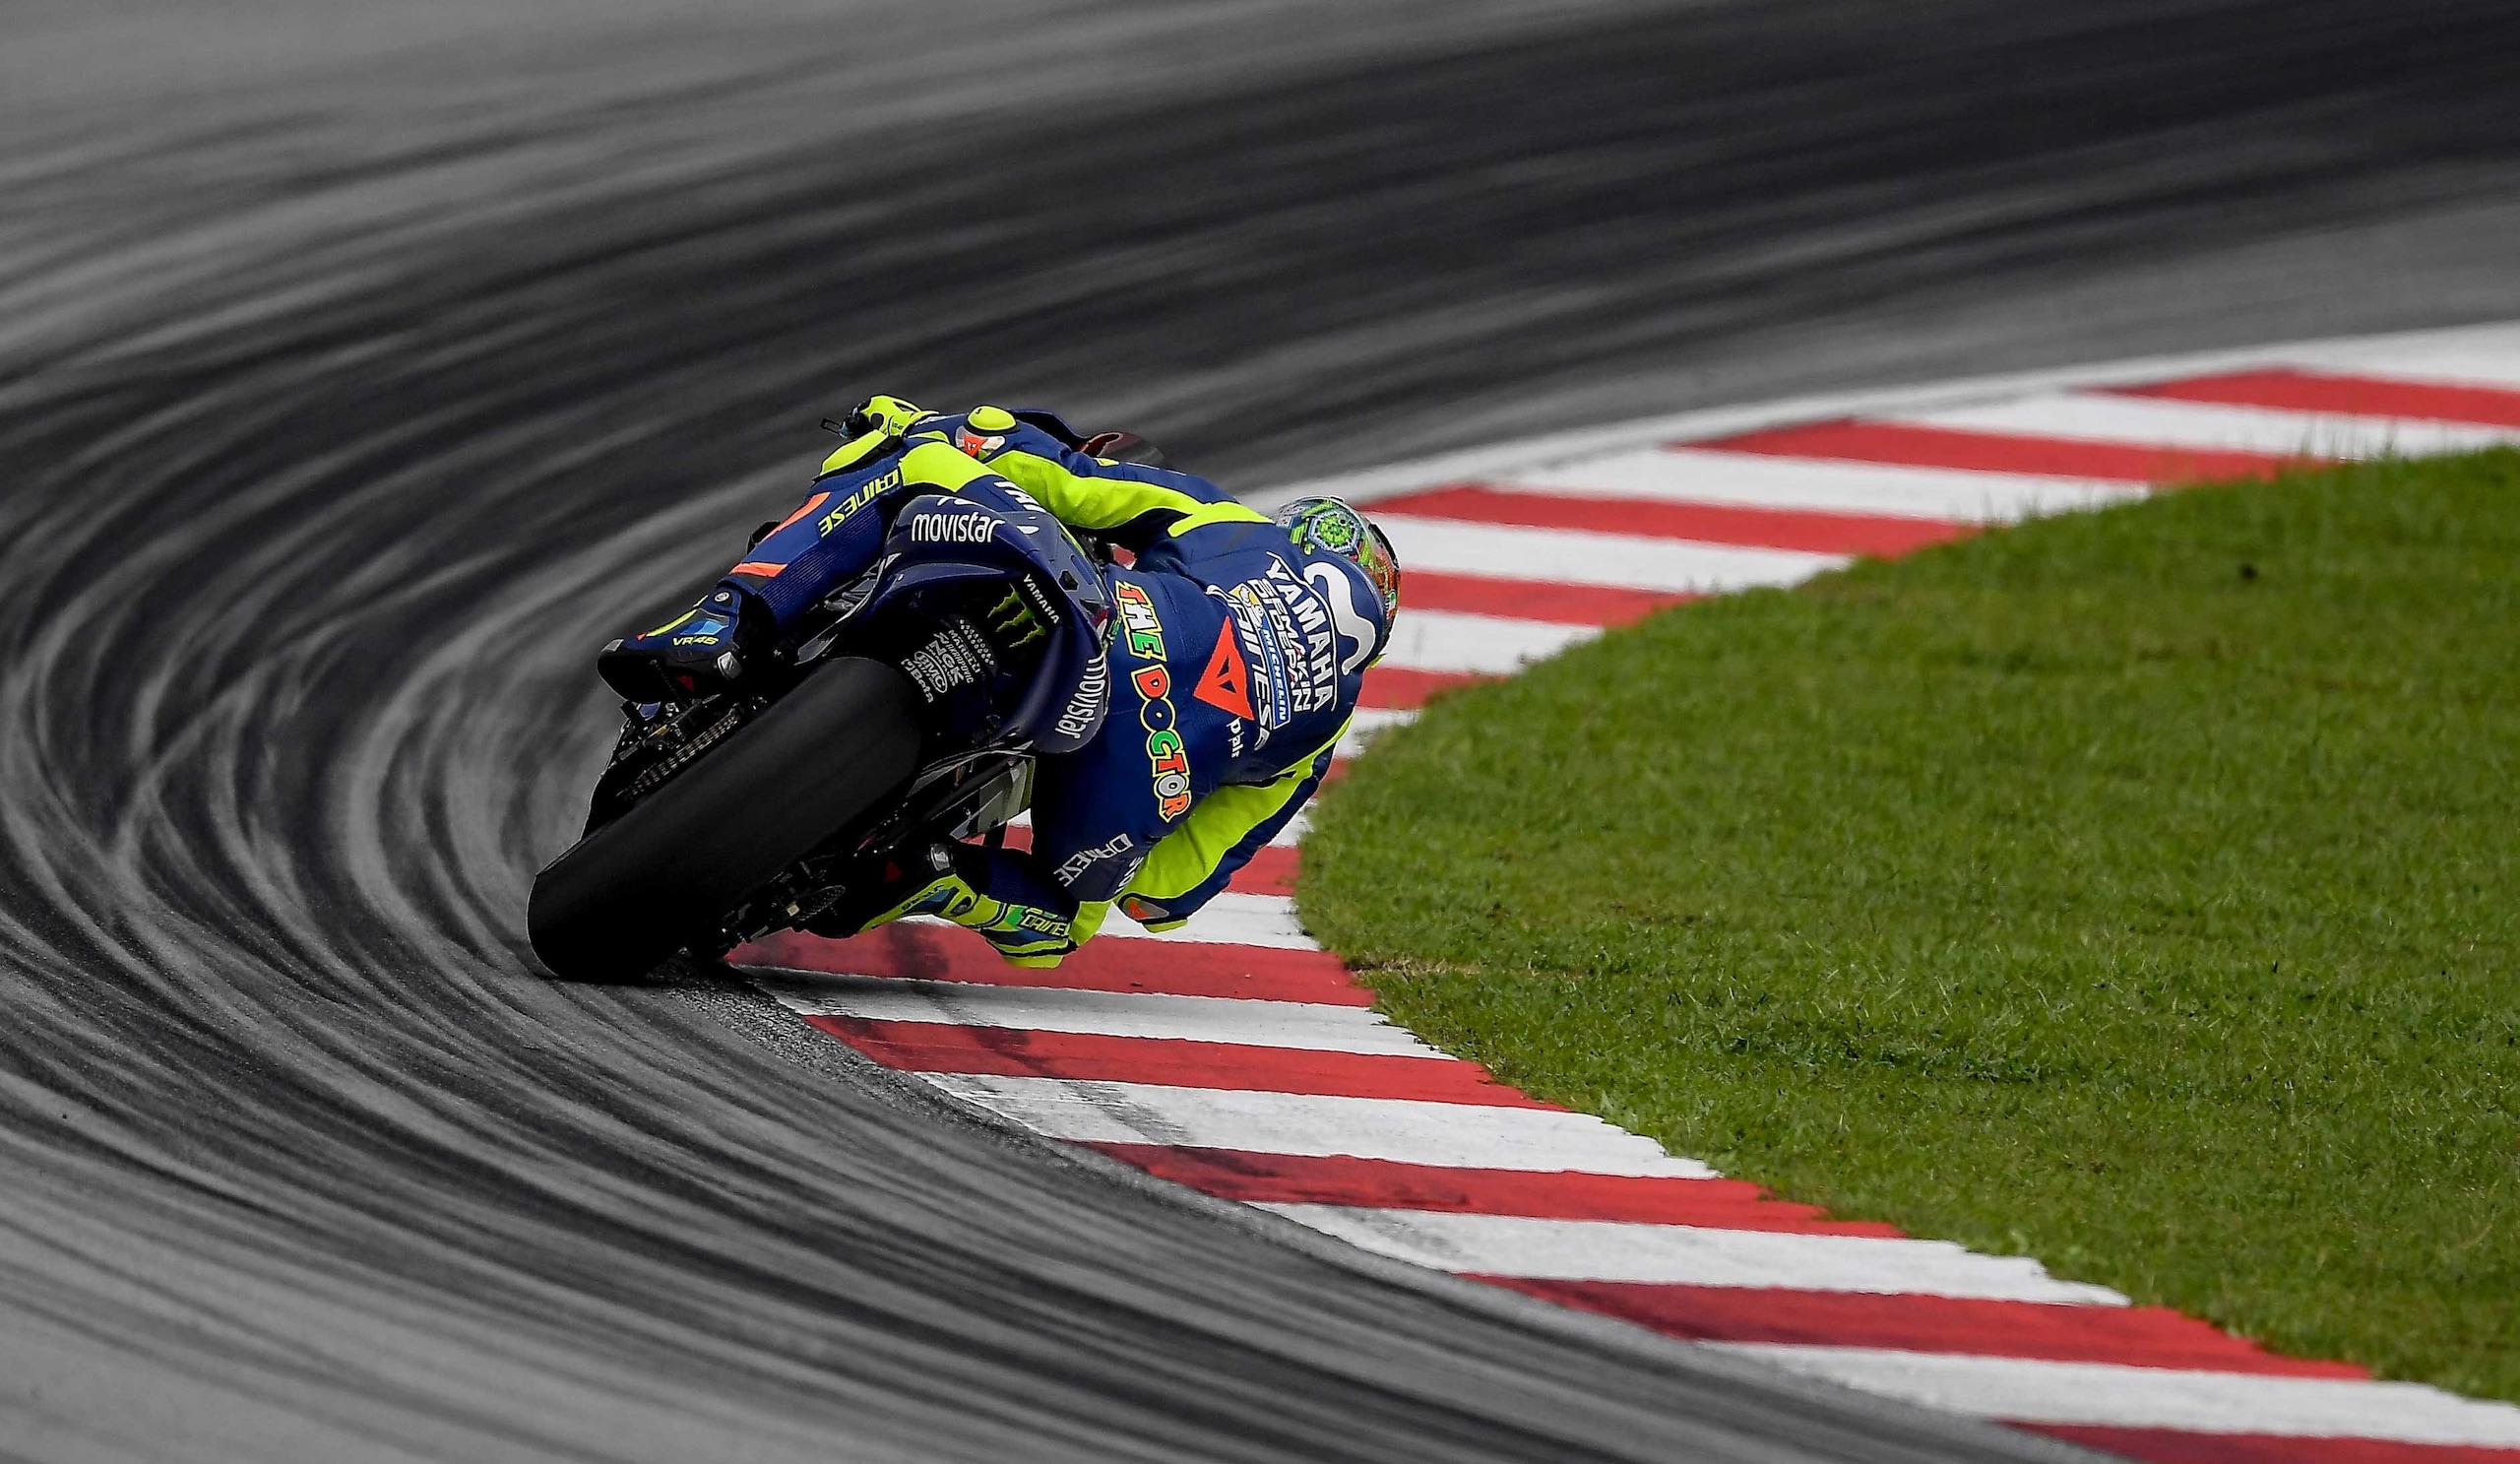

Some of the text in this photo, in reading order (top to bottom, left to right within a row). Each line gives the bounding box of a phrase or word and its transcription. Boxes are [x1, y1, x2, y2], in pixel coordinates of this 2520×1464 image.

[818, 469, 900, 538] DAINESE
[912, 511, 1005, 542] movistar
[1023, 573, 1060, 624] YAMAHA
[1266, 558, 1333, 712] YAMAHA
[928, 640, 964, 684] NGK
[1054, 650, 1106, 739] movistar
[1115, 580, 1192, 823] THE DOCTOR
[1261, 628, 1288, 722] MICHELIN
